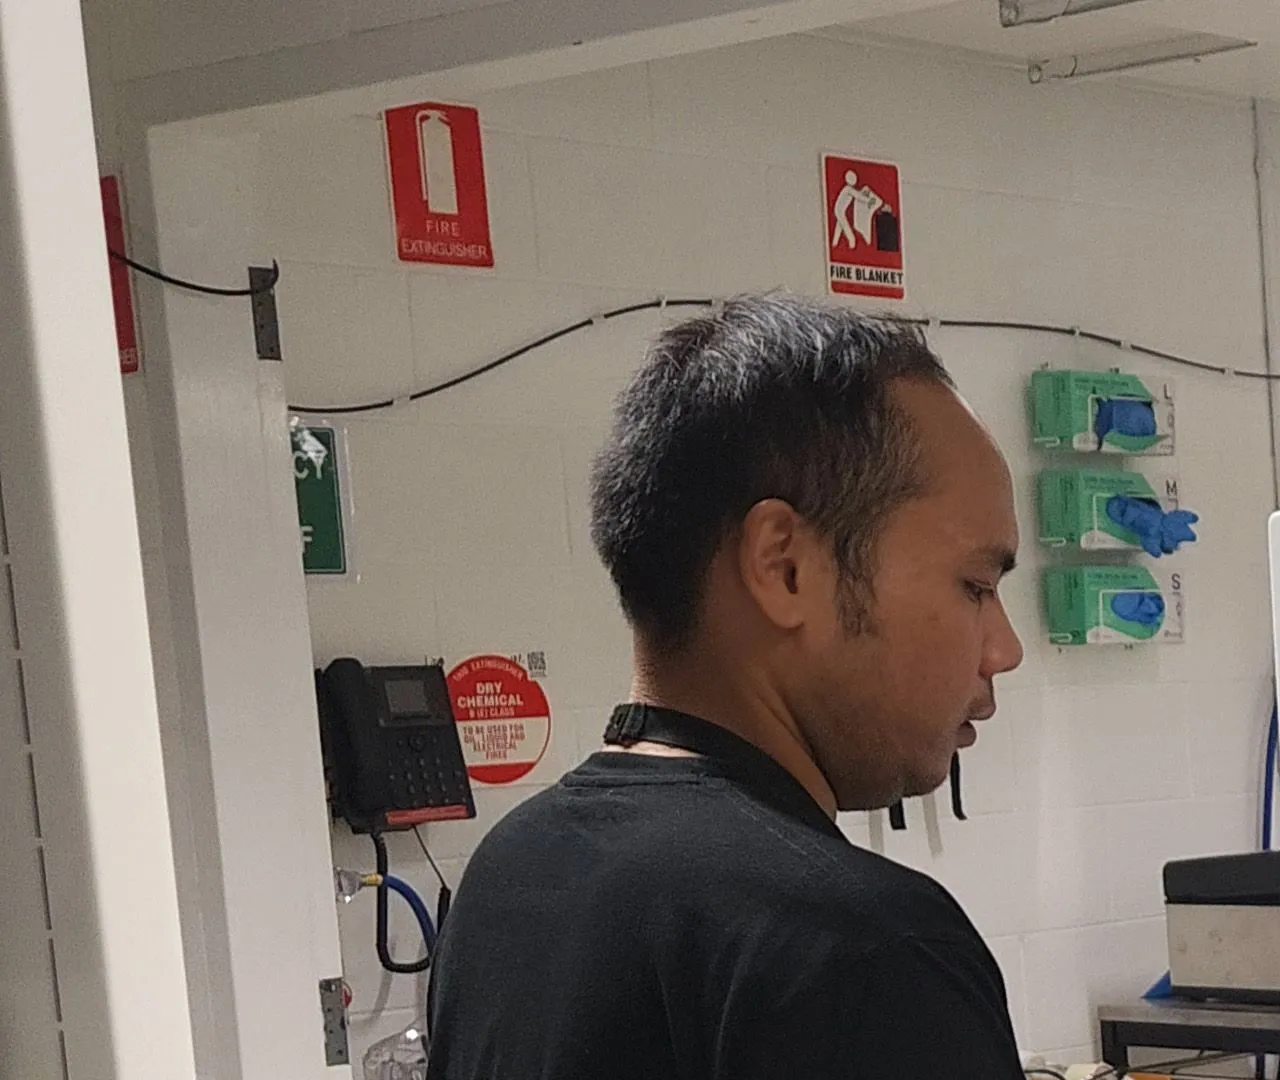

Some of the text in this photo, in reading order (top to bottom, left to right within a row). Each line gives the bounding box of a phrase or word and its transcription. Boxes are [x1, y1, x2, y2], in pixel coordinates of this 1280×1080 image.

[426, 220, 459, 237] FIRE
[401, 239, 488, 259] EXTINGUISHER
[831, 265, 904, 285] FIRE BLANKET
[476, 682, 502, 694] DRY
[457, 694, 524, 709] CHEMICAL
